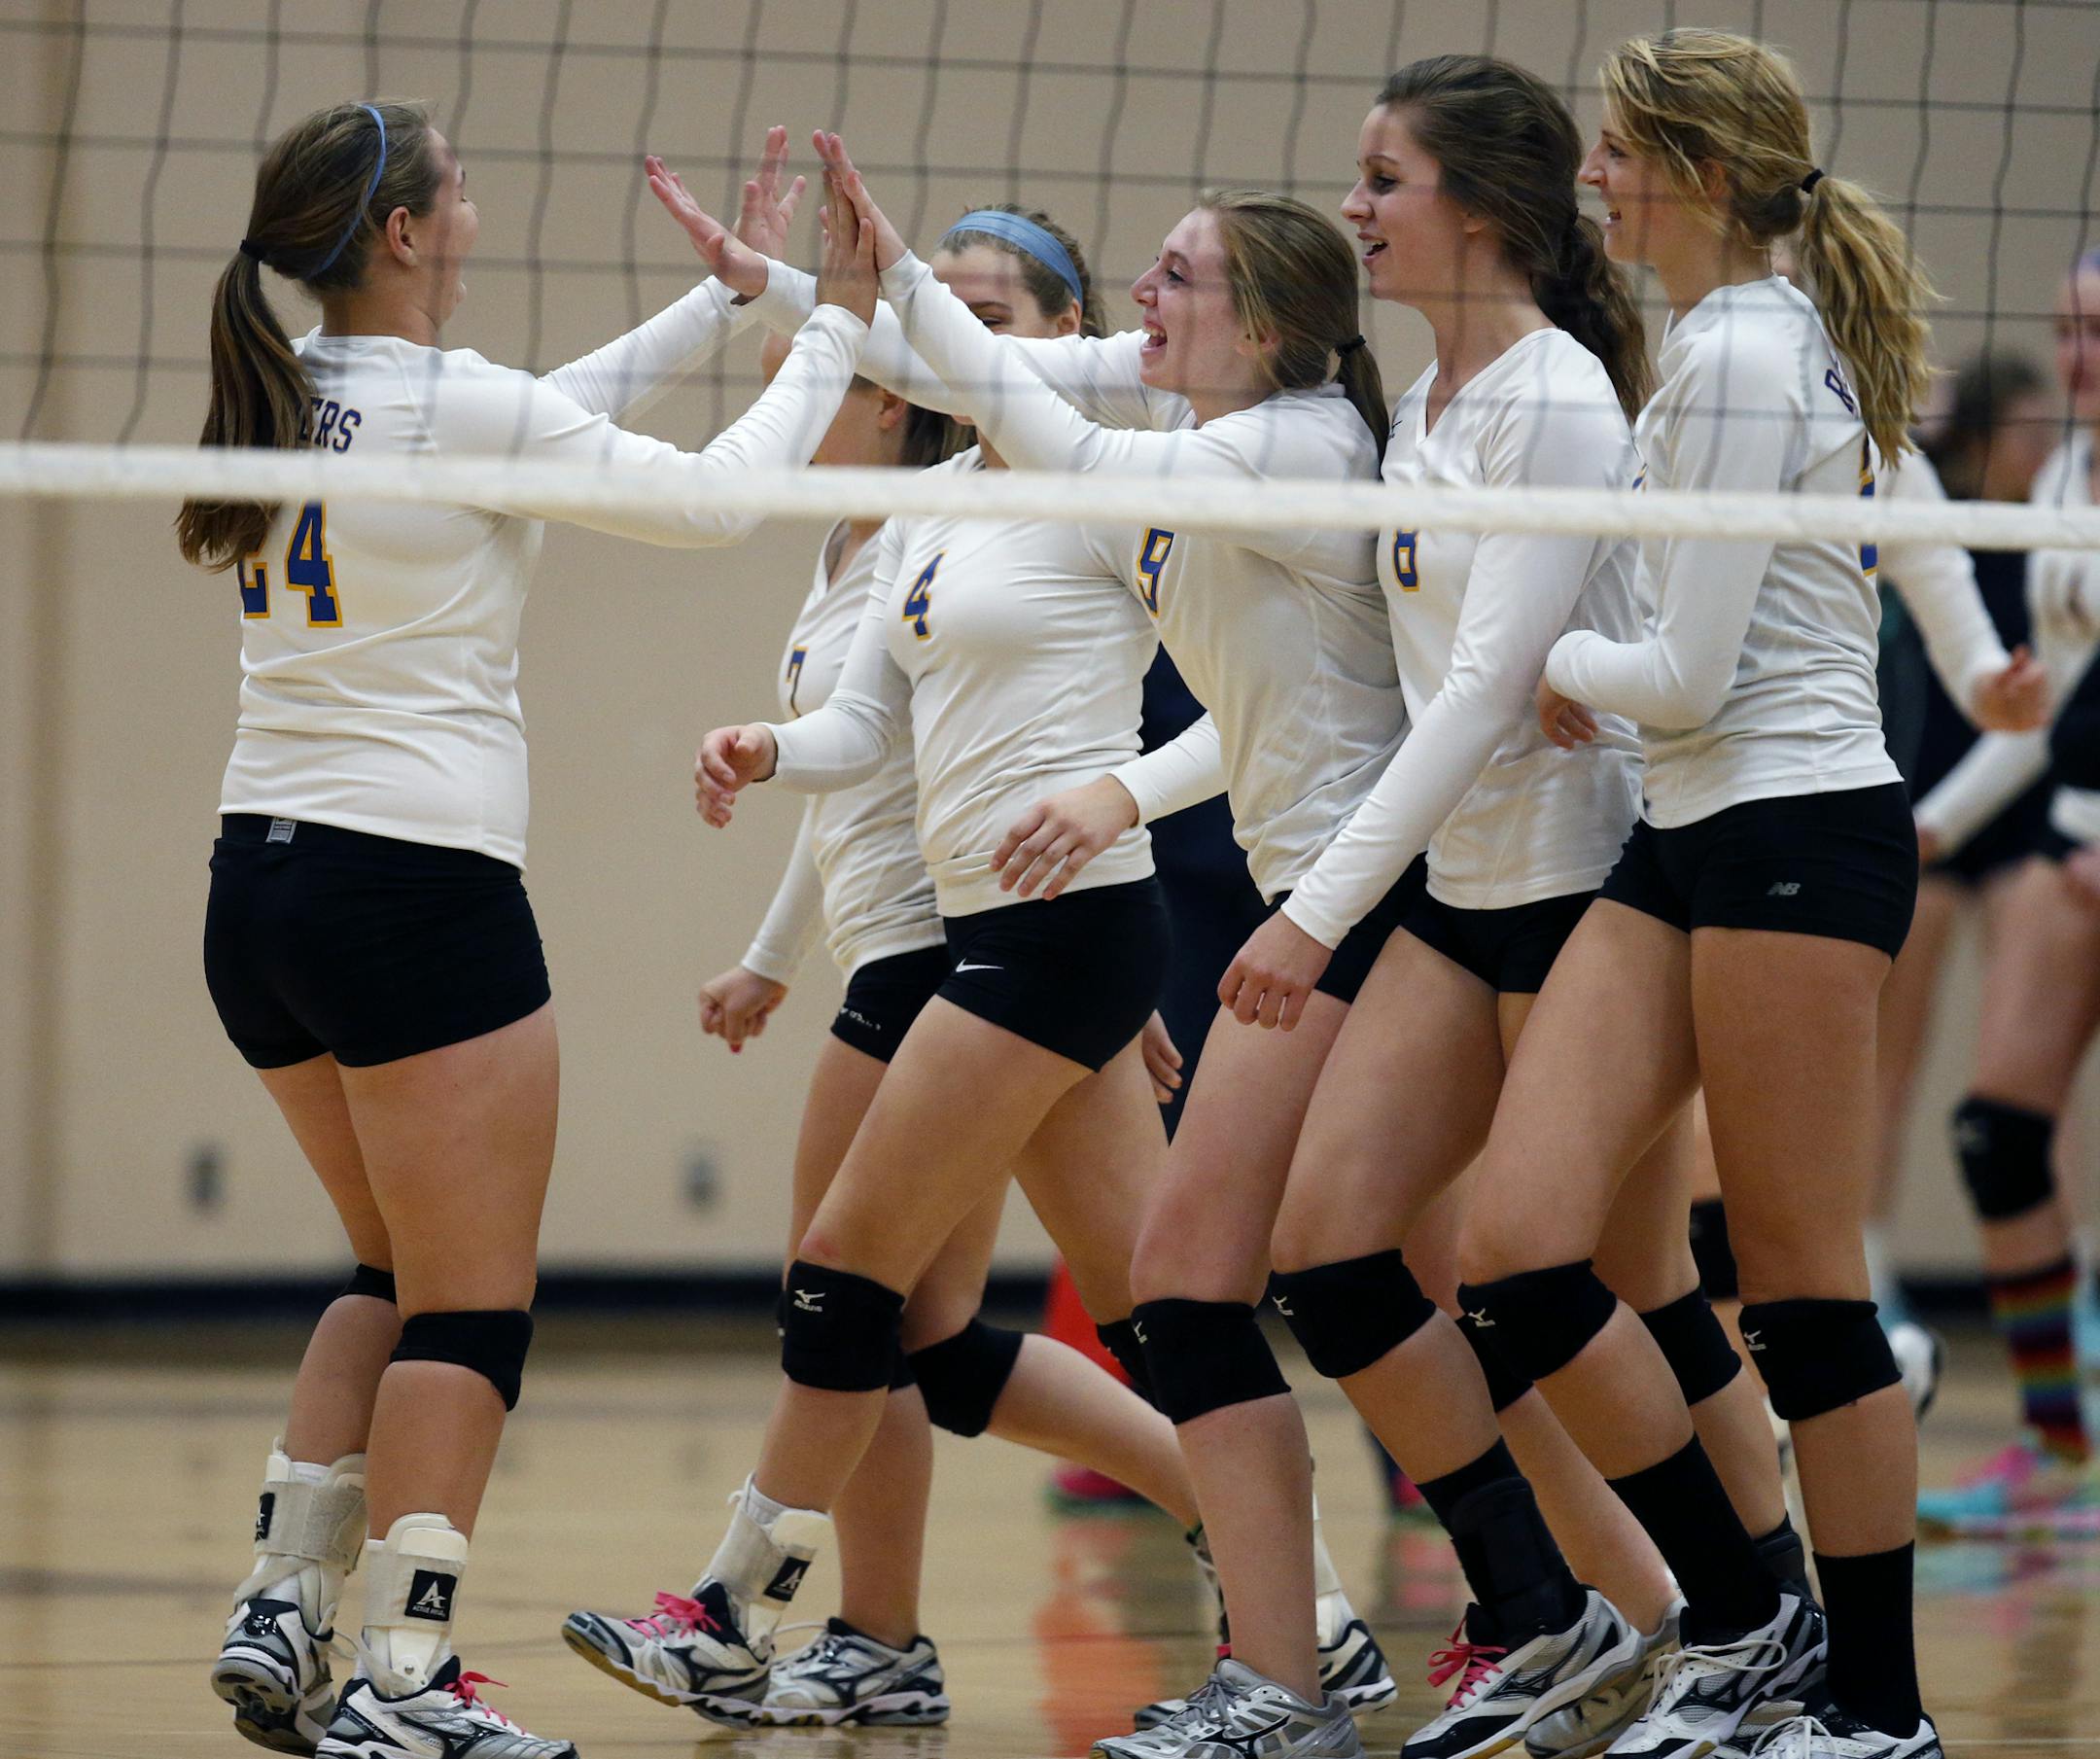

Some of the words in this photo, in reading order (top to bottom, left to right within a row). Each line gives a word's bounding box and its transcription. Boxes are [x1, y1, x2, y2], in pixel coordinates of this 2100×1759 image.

[901, 549, 948, 641] 4
[1137, 527, 1174, 618] 9
[787, 645, 809, 718] 7
